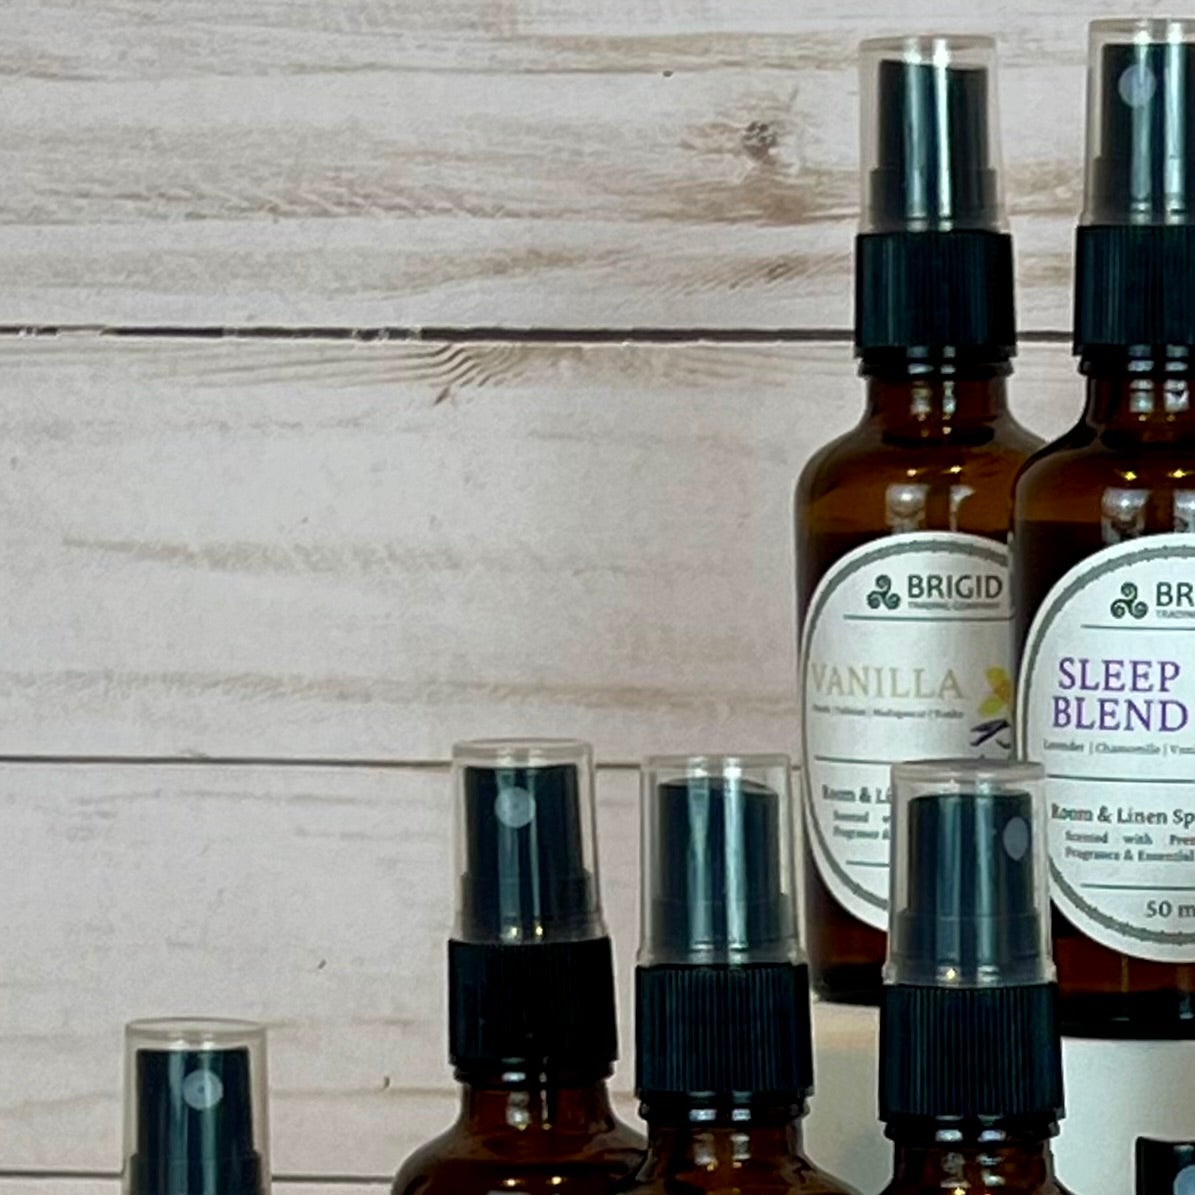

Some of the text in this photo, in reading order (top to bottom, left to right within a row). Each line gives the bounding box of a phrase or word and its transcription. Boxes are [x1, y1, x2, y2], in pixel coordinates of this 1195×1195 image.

[908, 574, 1003, 599] BRIGID
[810, 661, 964, 700] VANILLA
[1059, 657, 1181, 692] SLEEP
[1051, 696, 1188, 732] BLEND
[1051, 803, 1093, 822] Room
[1098, 806, 1112, 823] &
[1117, 808, 1168, 824] Linen
[1123, 833, 1153, 846] with
[1124, 848, 1134, 861] &
[1146, 901, 1173, 918] 50
